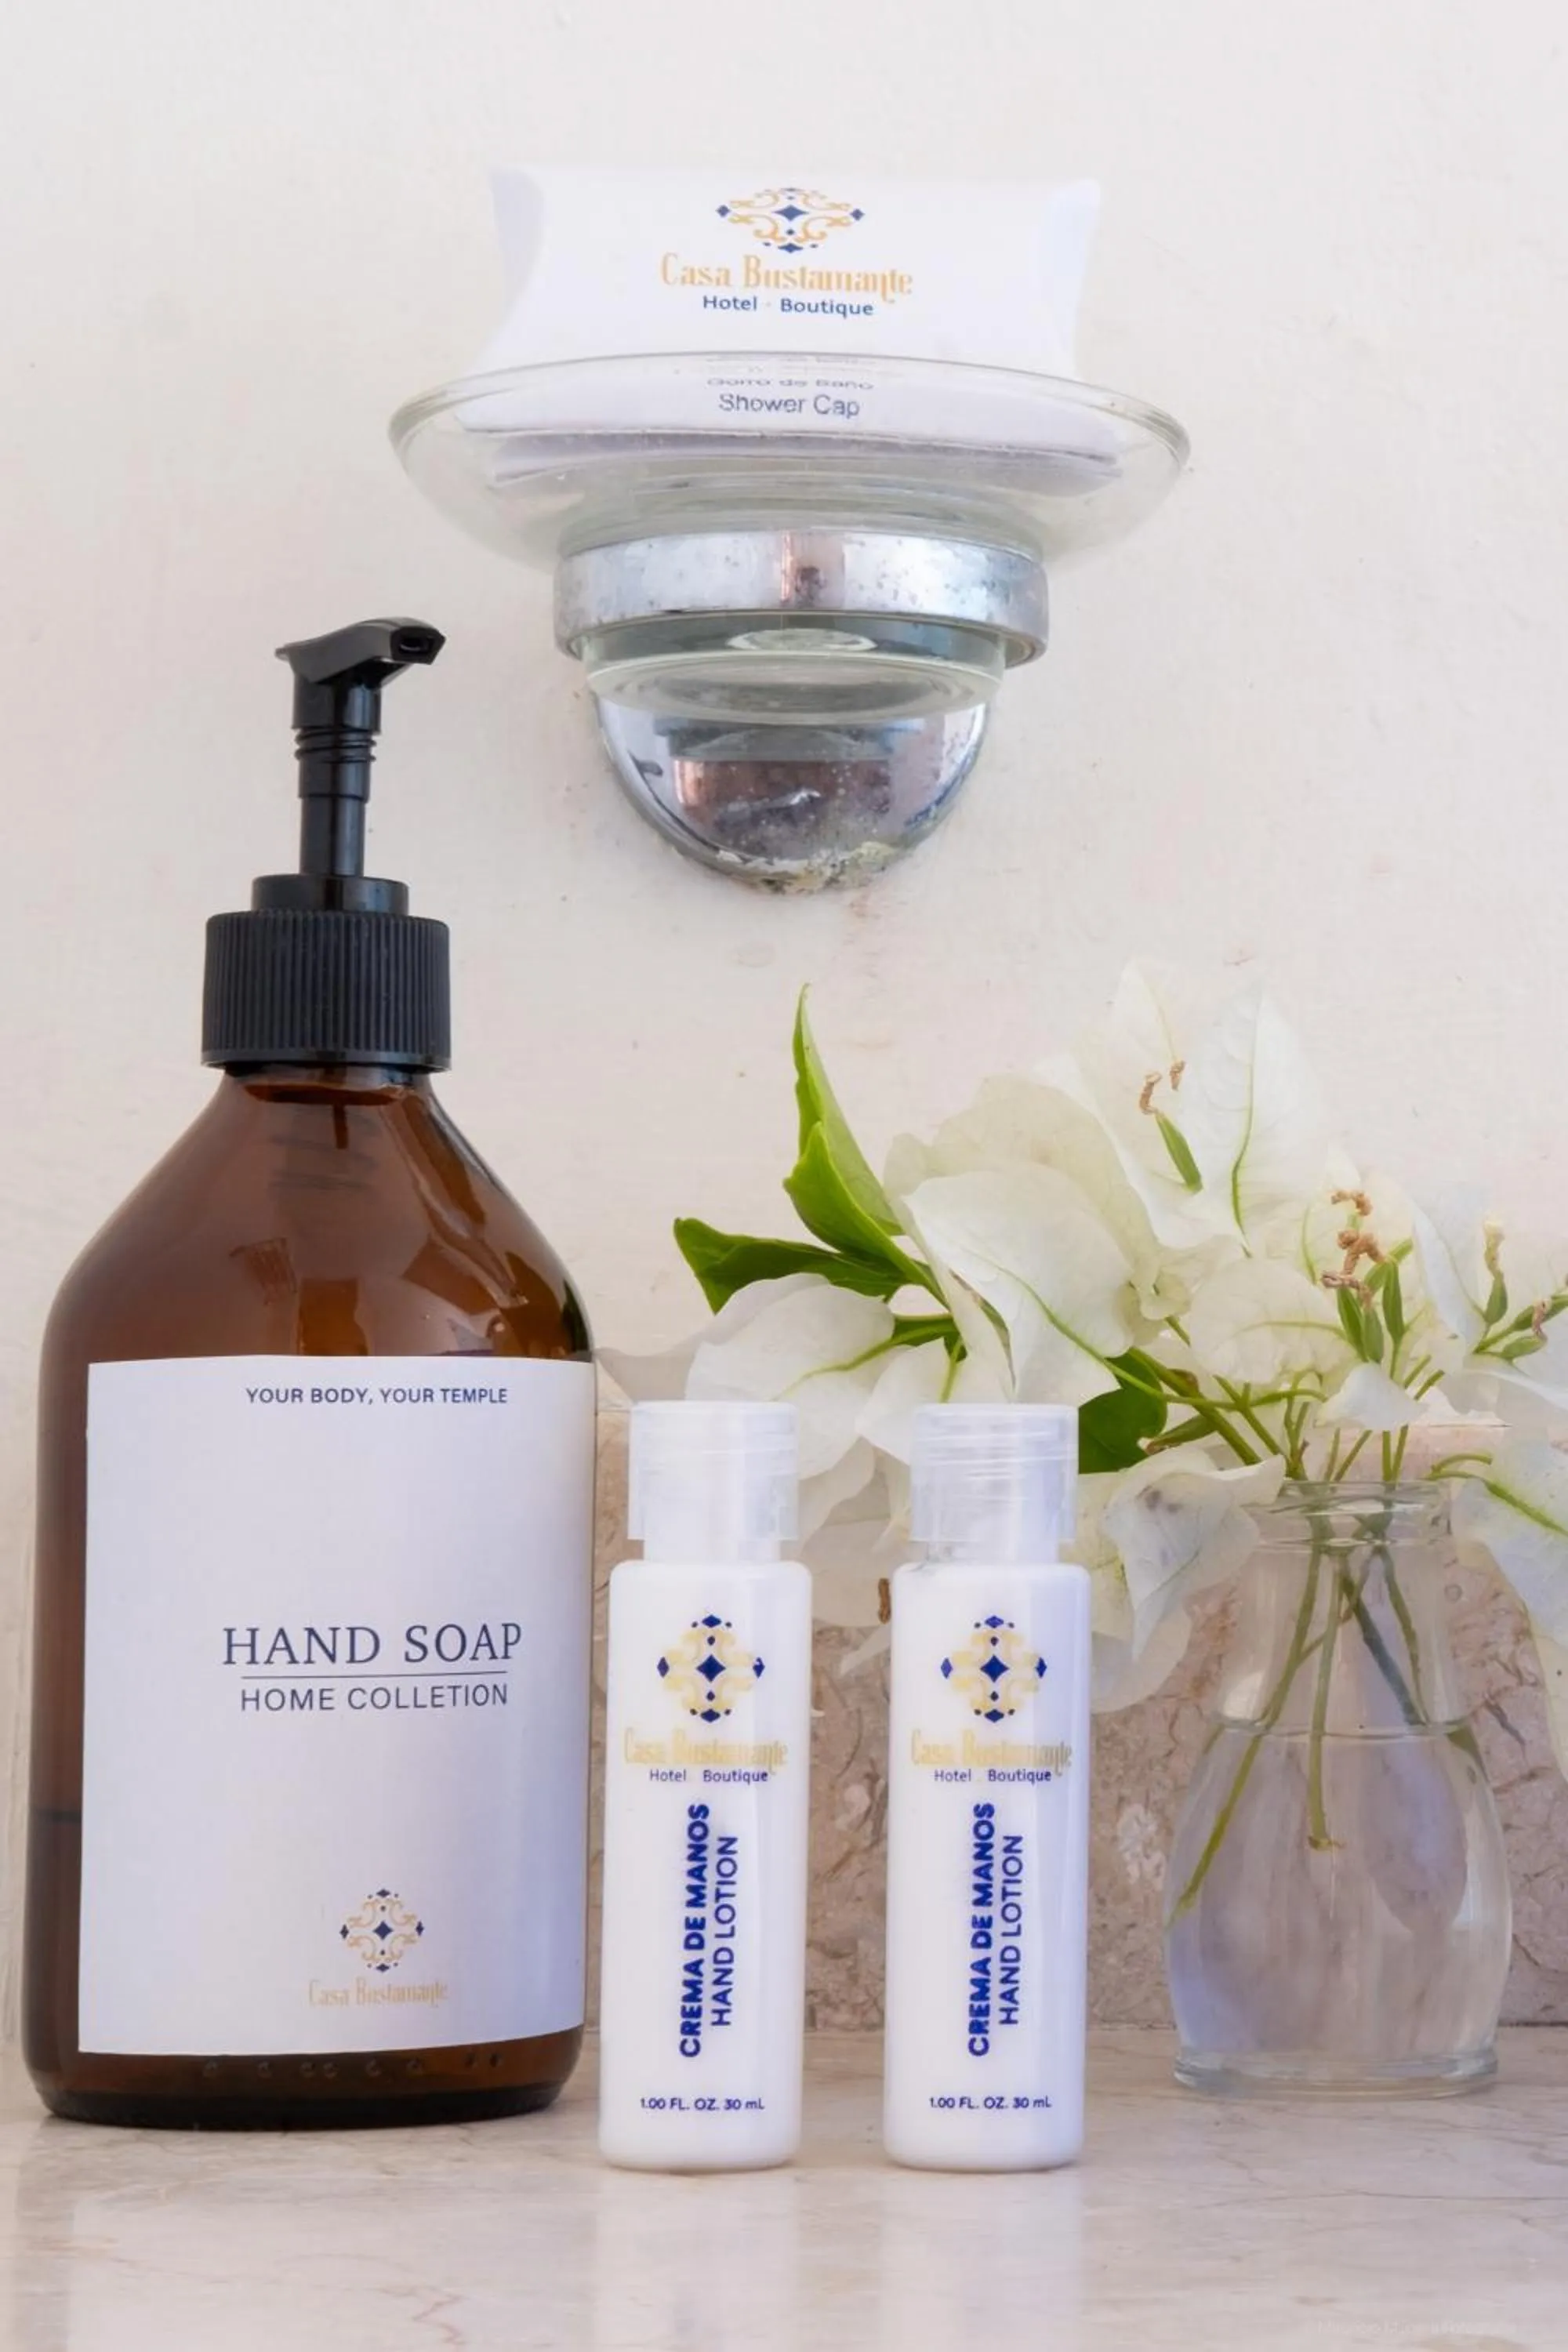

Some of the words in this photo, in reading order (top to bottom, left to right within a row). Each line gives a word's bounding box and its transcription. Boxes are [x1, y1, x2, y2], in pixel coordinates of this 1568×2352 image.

[661, 252, 732, 287] Casa
[742, 253, 913, 303] Bustamante
[703, 296, 757, 310] Hotel
[781, 298, 873, 318] Boutique
[719, 394, 805, 413] Shower
[813, 394, 859, 419] Cap
[246, 1388, 303, 1403] YOUR
[311, 1388, 372, 1405] BODY,
[380, 1388, 434, 1403] YOUR
[440, 1388, 507, 1403] TEMPLE
[223, 1627, 379, 1664] HAND
[405, 1623, 521, 1662] SOAP
[241, 1689, 335, 1711] HOME
[348, 1684, 507, 1709] COLLETION
[625, 1728, 666, 1765] Casa
[911, 1729, 954, 1766] Casa
[650, 1769, 686, 1782] Hotel
[703, 1769, 768, 1784] Boutique
[935, 1769, 971, 1782] Hotel
[989, 1769, 1051, 1784] Boutique
[685, 1805, 709, 1908] MANOS
[972, 1803, 994, 1907] MANOS
[714, 1837, 737, 1938] LOTION
[1001, 1836, 1022, 1936] LOTION
[684, 1917, 706, 1951] DE
[971, 1915, 993, 1949] DE
[309, 1979, 350, 2007] Casa
[711, 1947, 734, 2026] HAND
[999, 1946, 1021, 2024] HAND
[680, 1958, 704, 2057] CREMA
[968, 1957, 991, 2056] CREMA
[641, 2098, 666, 2110] 1.00
[670, 2097, 690, 2111] FL.
[694, 2098, 719, 2111] OZ.
[724, 2099, 742, 2111] 30
[745, 2098, 764, 2110] mL
[930, 2097, 955, 2109] 1.00
[960, 2096, 979, 2109] FL.
[984, 2096, 1008, 2109] OZ.
[1013, 2097, 1029, 2109] 30
[1033, 2096, 1051, 2107] mL
